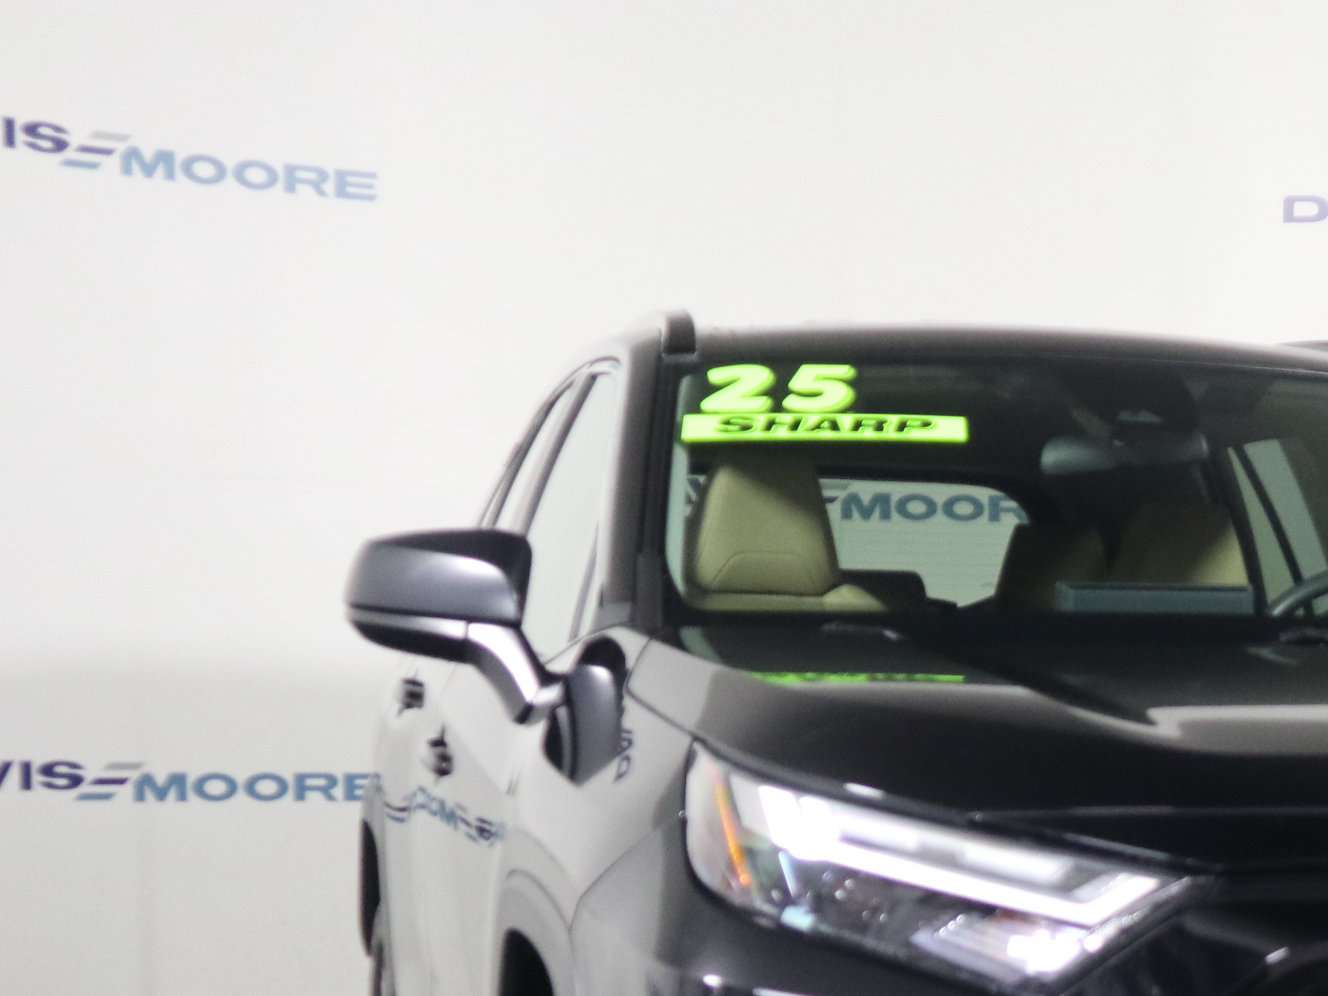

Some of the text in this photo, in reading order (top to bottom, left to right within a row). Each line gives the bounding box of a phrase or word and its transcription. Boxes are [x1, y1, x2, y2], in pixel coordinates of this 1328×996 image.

[118, 145, 379, 202] MOORE
[700, 363, 857, 413] 25
[716, 415, 937, 435] SHARP
[133, 772, 377, 802] MOORE
